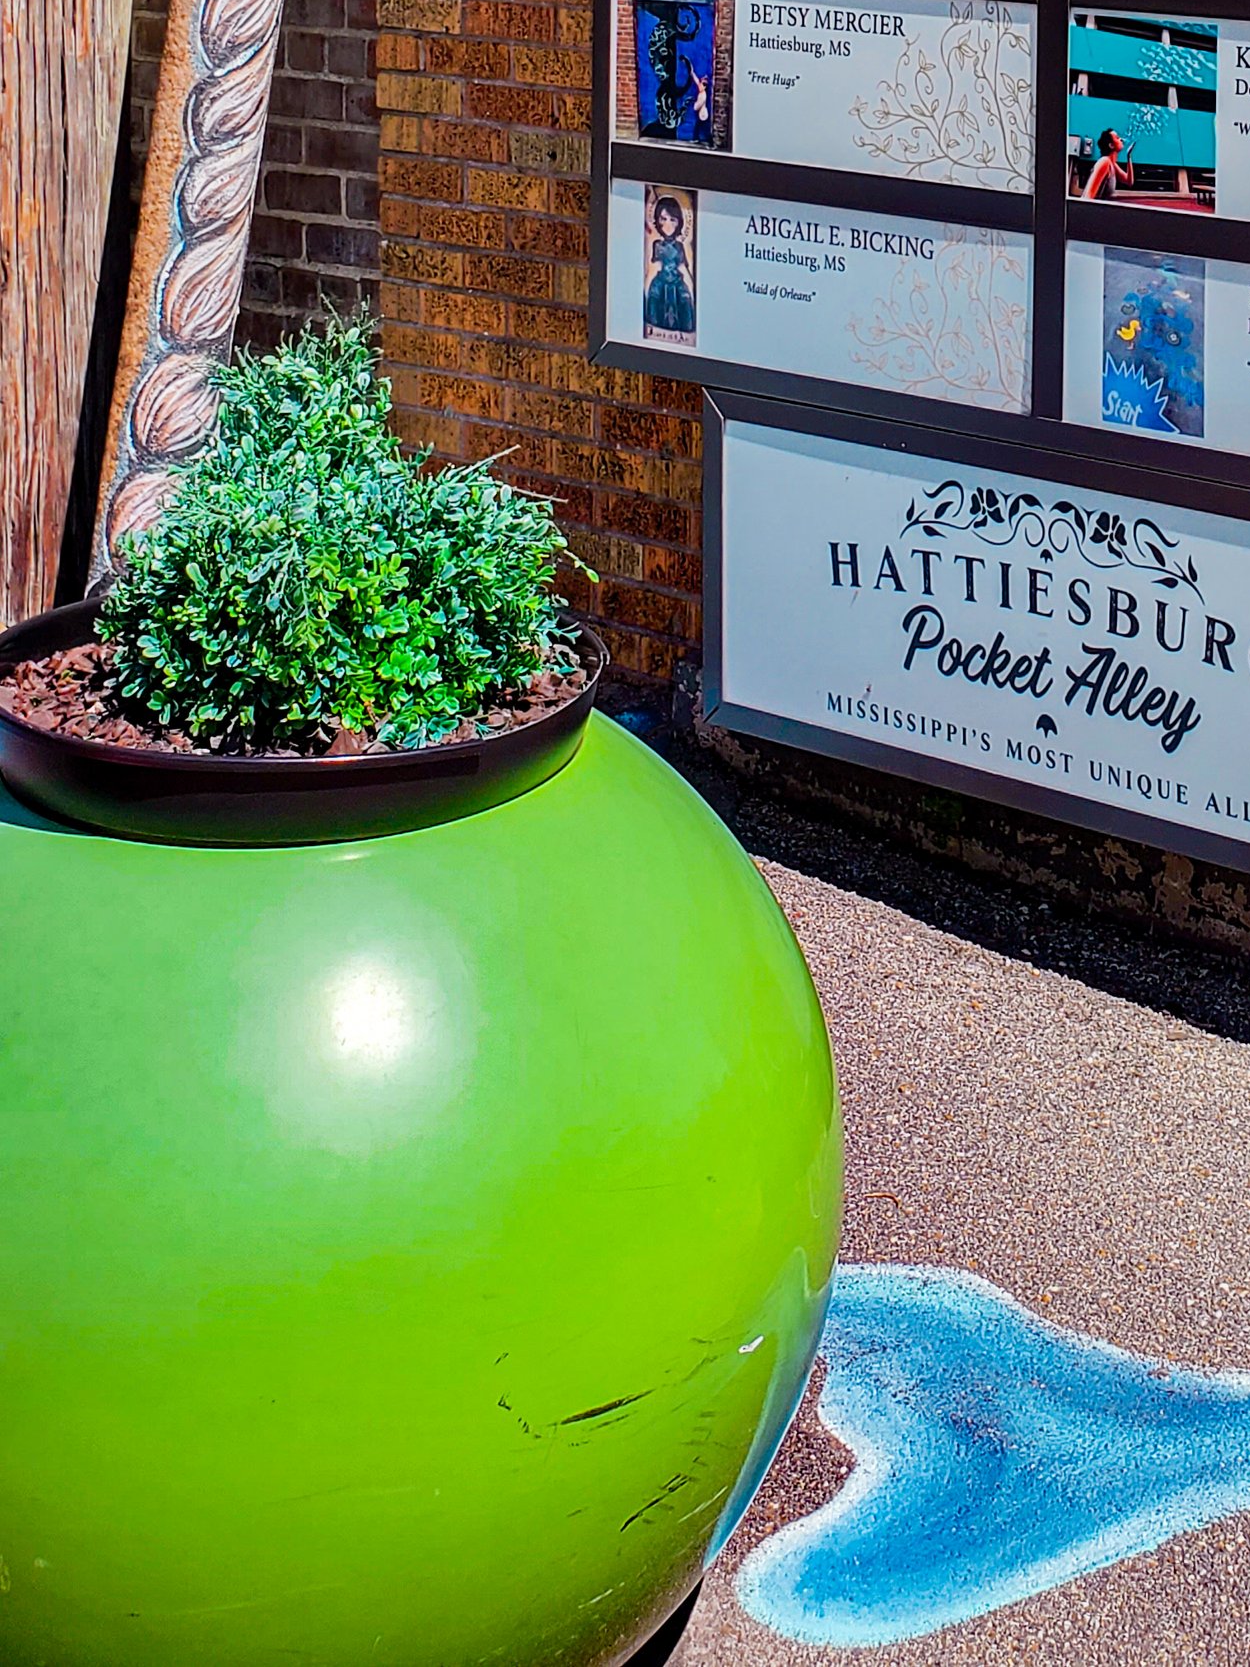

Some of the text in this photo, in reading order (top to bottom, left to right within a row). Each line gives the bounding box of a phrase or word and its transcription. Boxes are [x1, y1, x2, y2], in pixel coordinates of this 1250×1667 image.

[750, 3, 906, 37] BETSY MERCIER
[749, 32, 851, 59] Hattiesburg, MS
[745, 215, 934, 260] ABIGAIL E. BICKING
[745, 242, 845, 272] Hattiesburg, MS
[769, 286, 779, 300] of
[1103, 390, 1142, 427] Start
[902, 604, 1202, 754] Pocket Alley
[827, 692, 990, 752] MISSISSIPPI'S
[1006, 738, 1073, 773] MOST
[1089, 760, 1188, 805] UNIQUE
